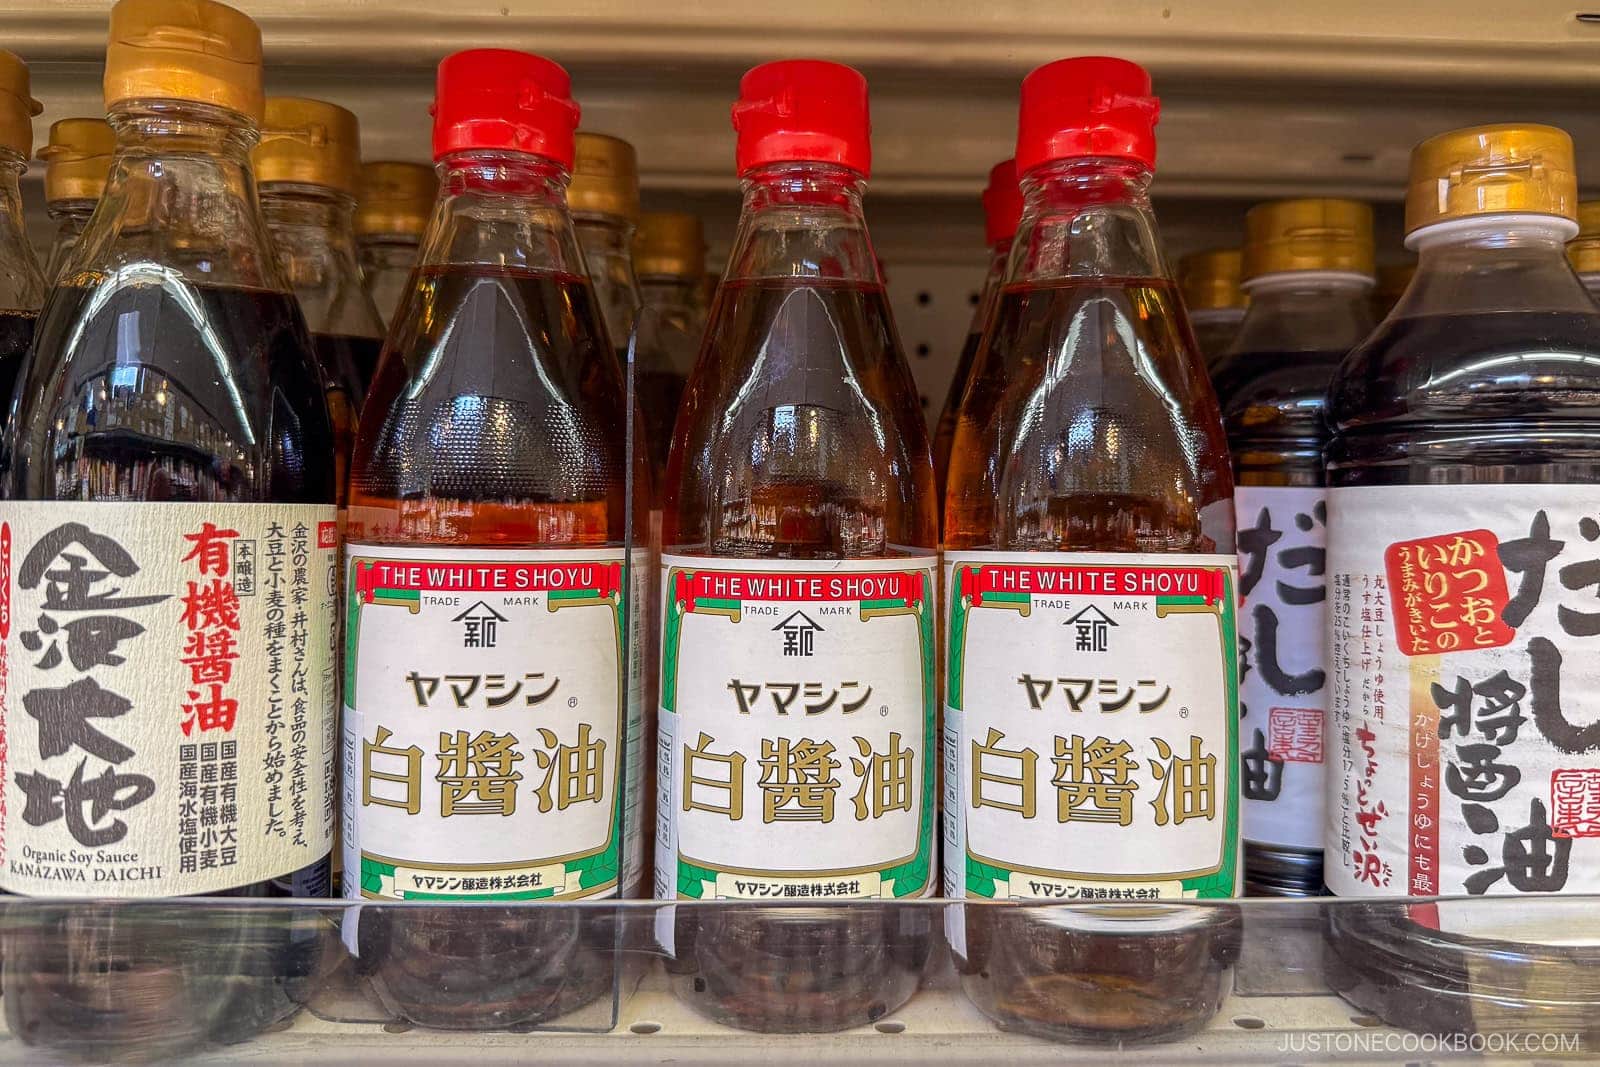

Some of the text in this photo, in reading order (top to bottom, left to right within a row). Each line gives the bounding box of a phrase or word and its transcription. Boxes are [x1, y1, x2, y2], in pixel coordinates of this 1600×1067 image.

[236, 543, 254, 593] 本醸造
[380, 565, 594, 588] THE WHITE SHOYU
[990, 569, 1200, 593] THE WHITE SHOYU
[422, 596, 540, 607] TRADE MARK
[702, 576, 901, 598] THE WHITE SHOYU
[1398, 546, 1430, 653] うまみがきいた
[1415, 543, 1460, 650] いりこの
[1446, 536, 1496, 645] かつおと
[744, 606, 853, 616] TRADE MARK
[1033, 599, 1148, 611] TRADE MARK
[405, 671, 560, 709] ヤマシン
[726, 678, 872, 716] ヤマシン
[1017, 673, 1172, 713] ヤマシン
[178, 743, 198, 874] 国産海水塩使用
[199, 742, 219, 870] 国産有機小麦
[220, 740, 239, 867] 国産有機大豆
[10, 859, 163, 882] KANAZAWA DAICHI
[22, 846, 139, 865] Organic Soy Sauce
[412, 872, 543, 892] ヤマシン醸造株式会社
[734, 879, 861, 899] ヤマシン醸造株式会社
